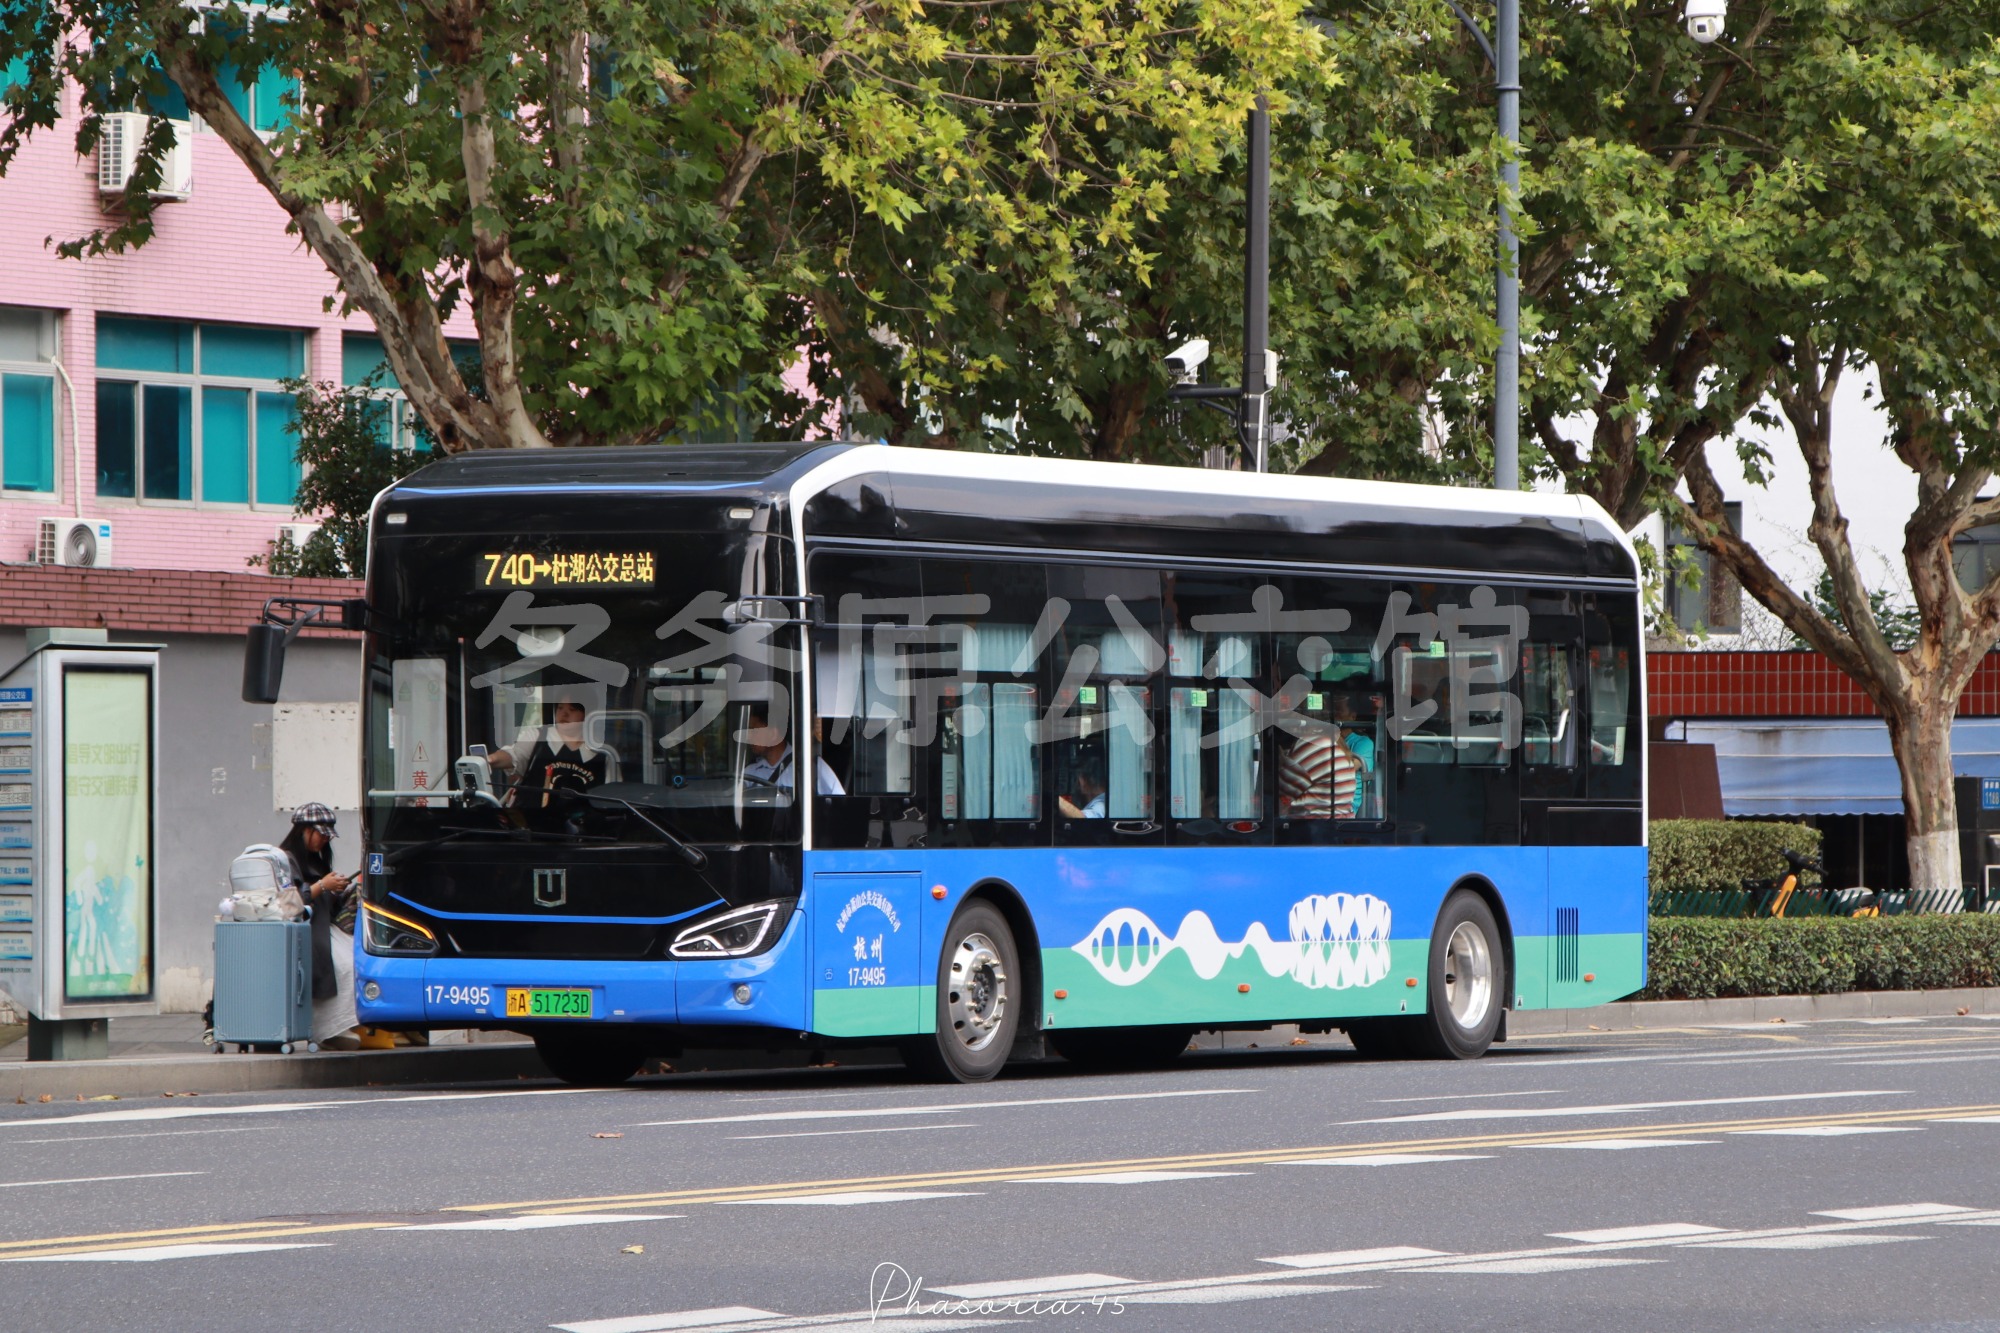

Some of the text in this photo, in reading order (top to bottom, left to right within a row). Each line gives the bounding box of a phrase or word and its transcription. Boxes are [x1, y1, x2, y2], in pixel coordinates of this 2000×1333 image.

[484, 552, 654, 586] 740 杜湖公交总站
[853, 933, 883, 964] 杭州
[848, 967, 886, 986] 17-9495
[425, 985, 490, 1006] 17-9495
